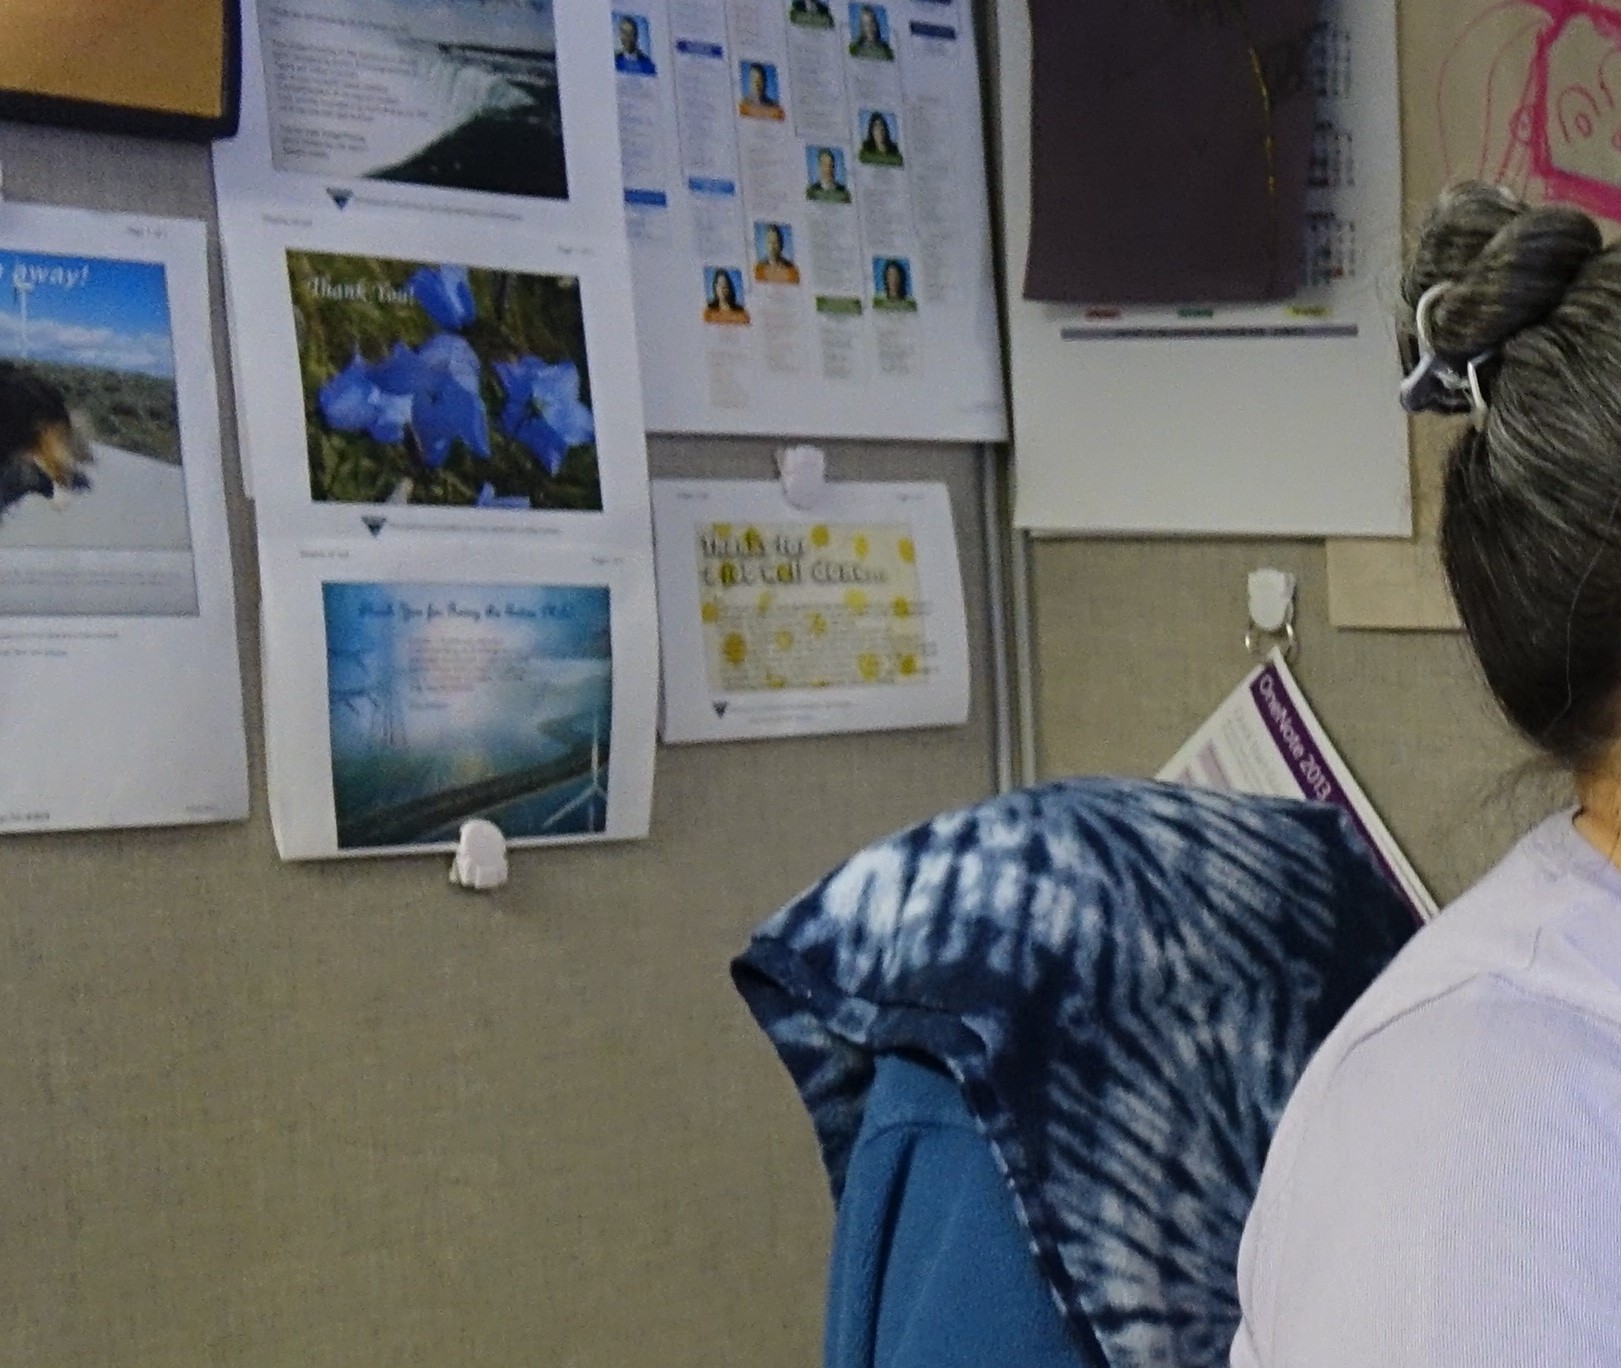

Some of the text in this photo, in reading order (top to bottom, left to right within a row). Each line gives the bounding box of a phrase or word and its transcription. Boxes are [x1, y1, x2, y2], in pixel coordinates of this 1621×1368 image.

[308, 278, 366, 302] Thank
[1259, 673, 1332, 802] OneNote 2013
